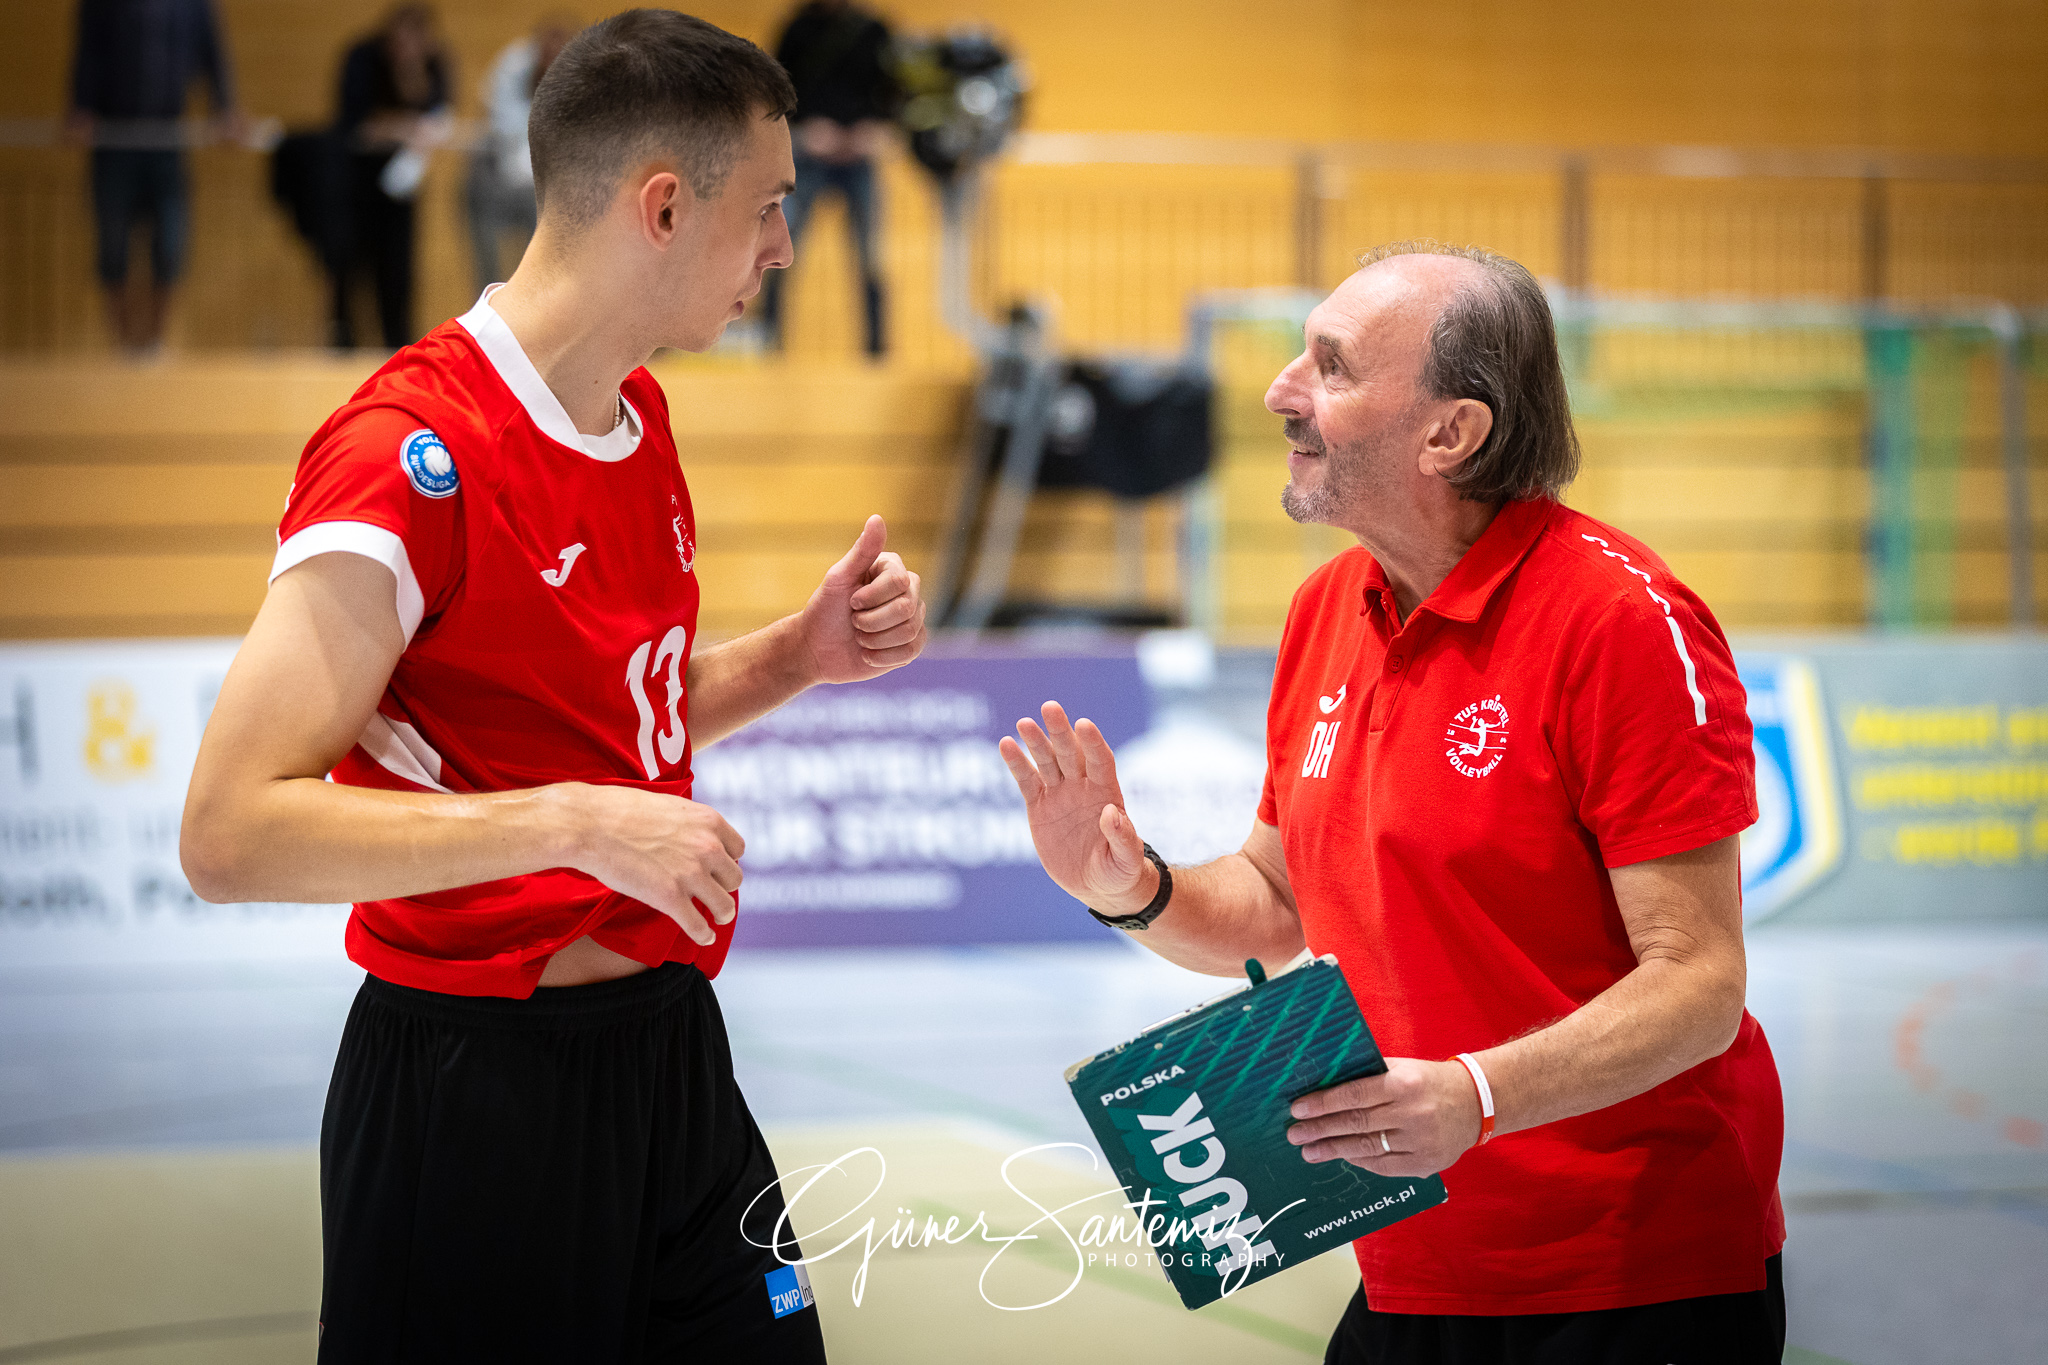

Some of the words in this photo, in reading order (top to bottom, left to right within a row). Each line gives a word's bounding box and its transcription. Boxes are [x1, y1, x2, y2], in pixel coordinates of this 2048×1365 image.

[410, 454, 452, 489] BUNDESLIGA
[624, 625, 686, 781] 13
[1454, 702, 1478, 723] TUS
[1480, 698, 1509, 729] KRIFTEL
[1302, 721, 1341, 778] DH
[1446, 747, 1503, 778] VOLLEYBALL
[1100, 1064, 1186, 1106] POLSKA
[1136, 1091, 1278, 1277] HUCK
[1304, 1185, 1416, 1240] www.huck.pl
[771, 1288, 800, 1313] ZWP
